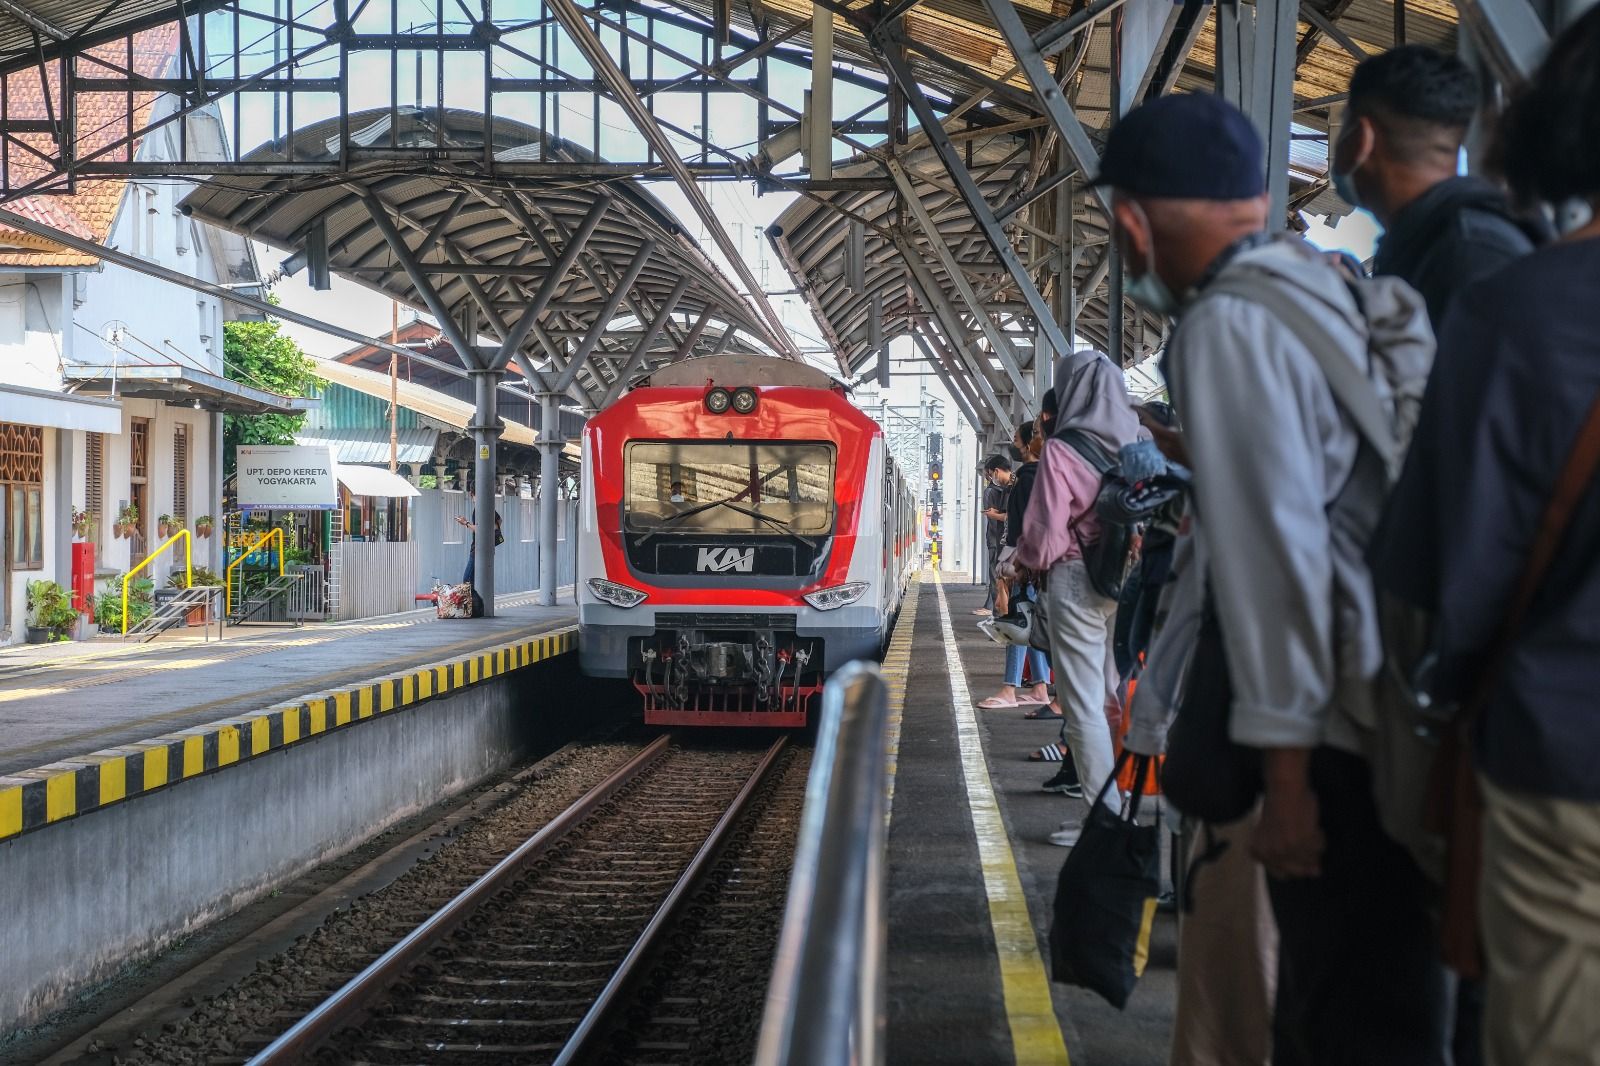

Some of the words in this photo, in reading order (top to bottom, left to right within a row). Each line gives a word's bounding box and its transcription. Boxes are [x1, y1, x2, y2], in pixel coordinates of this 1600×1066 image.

[246, 468, 265, 476] UPT.
[267, 468, 291, 476] DEPO
[293, 468, 328, 476] KERETA
[257, 477, 317, 485] YOGYAKARTA
[696, 547, 755, 572] KAI
